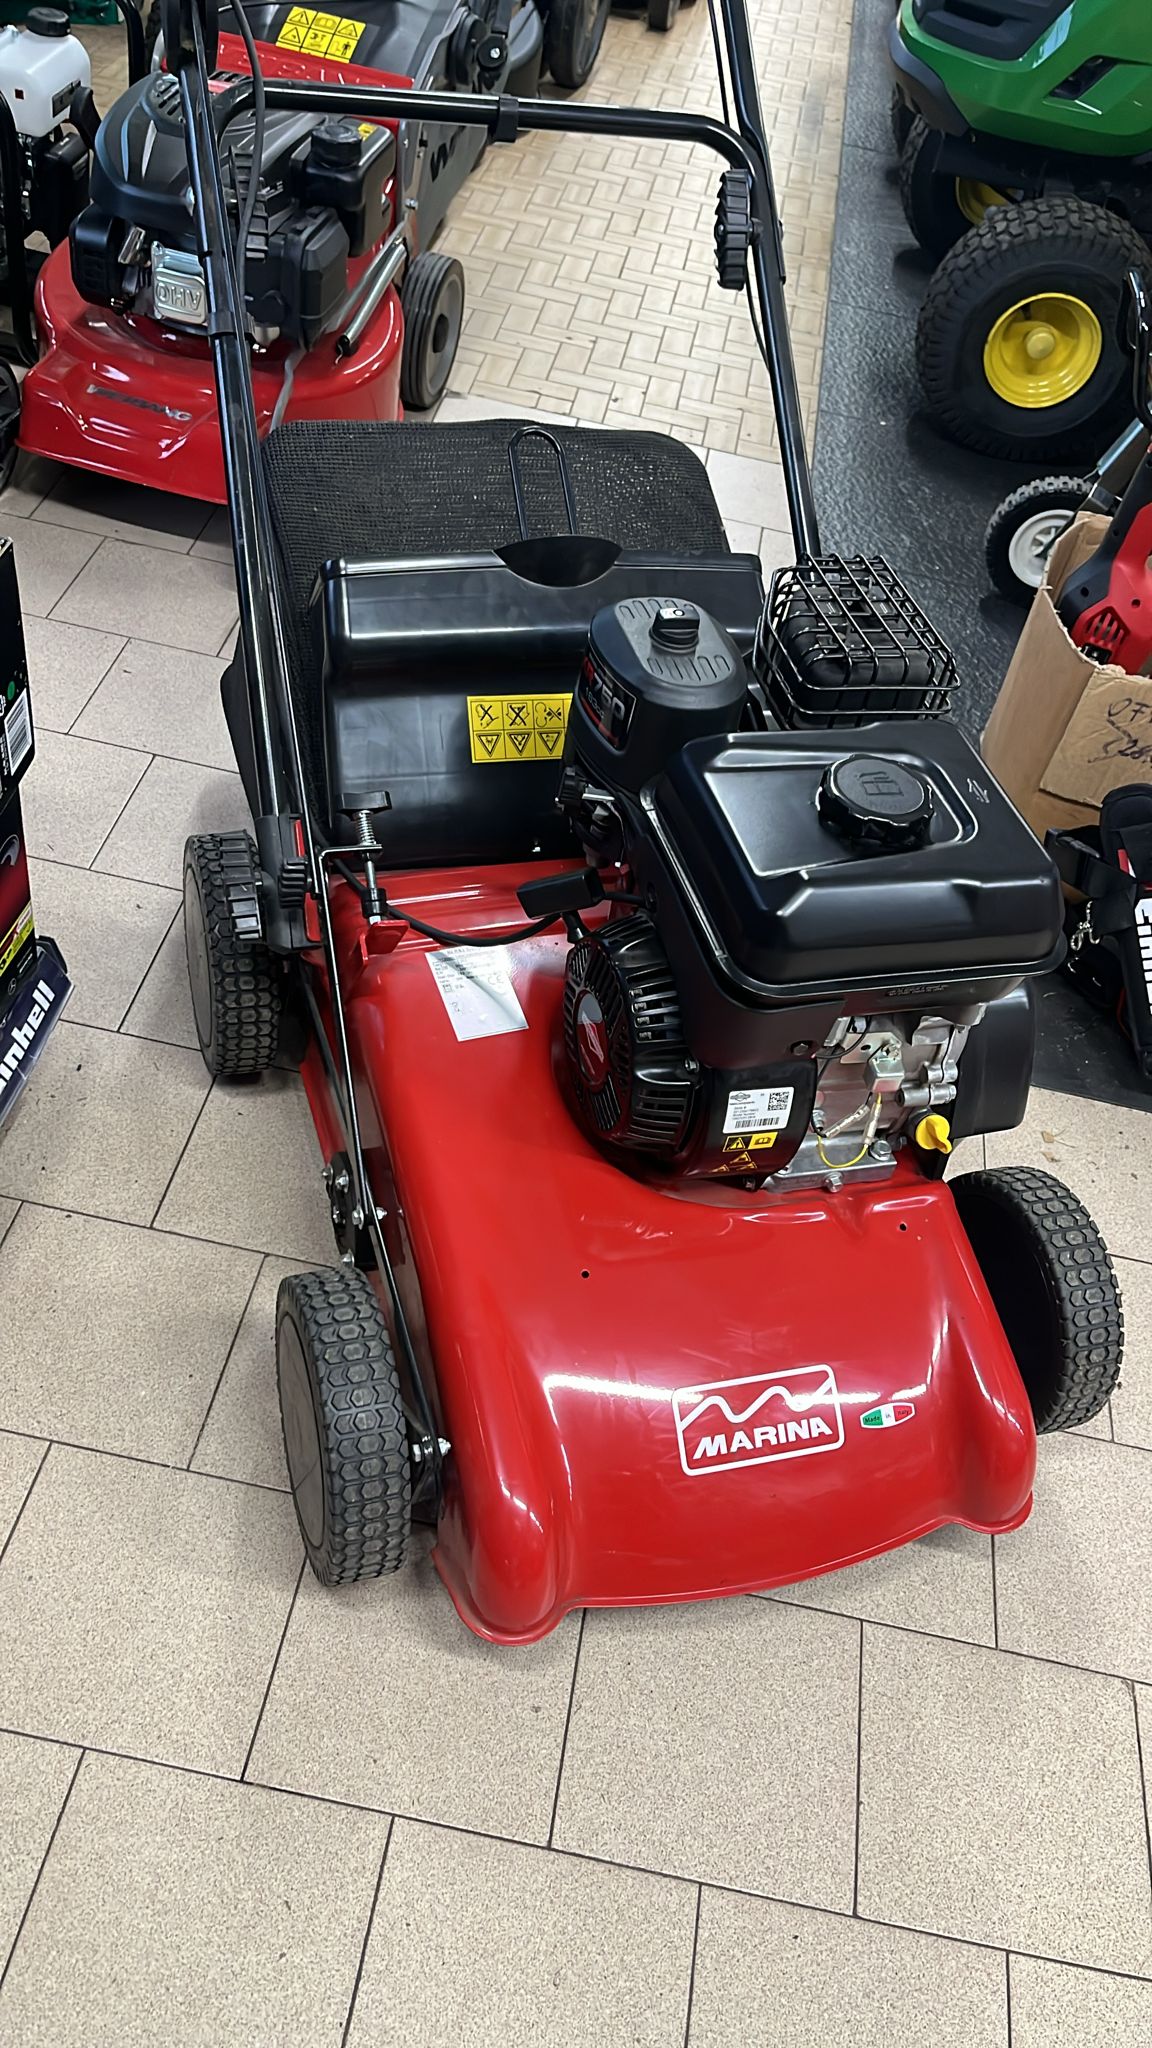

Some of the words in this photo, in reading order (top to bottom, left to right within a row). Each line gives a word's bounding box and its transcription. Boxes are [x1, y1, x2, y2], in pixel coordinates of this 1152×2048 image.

[156, 282, 202, 311] OHV
[864, 1415, 880, 1423] Made
[692, 1416, 833, 1460] MARINA
